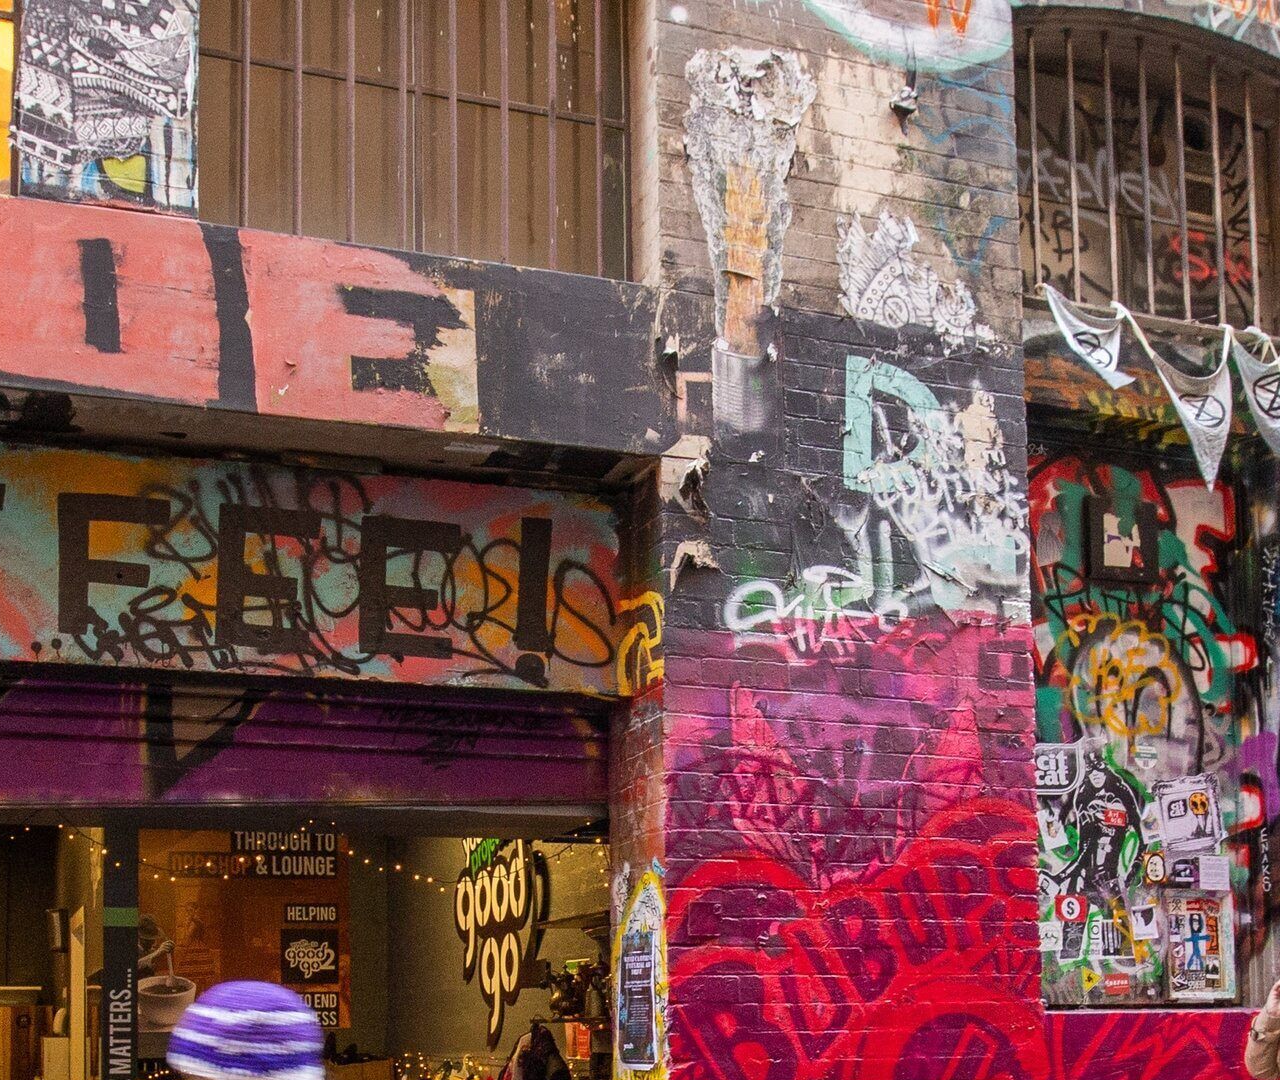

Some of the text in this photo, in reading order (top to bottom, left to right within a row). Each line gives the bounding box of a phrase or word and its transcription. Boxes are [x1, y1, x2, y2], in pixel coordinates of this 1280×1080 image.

[234, 831, 335, 851] THROUGH TO
[272, 856, 336, 876] LOUNGE
[457, 838, 525, 968] good
[287, 906, 336, 921] HELPING
[481, 932, 519, 1035] go
[313, 994, 337, 1008] END
